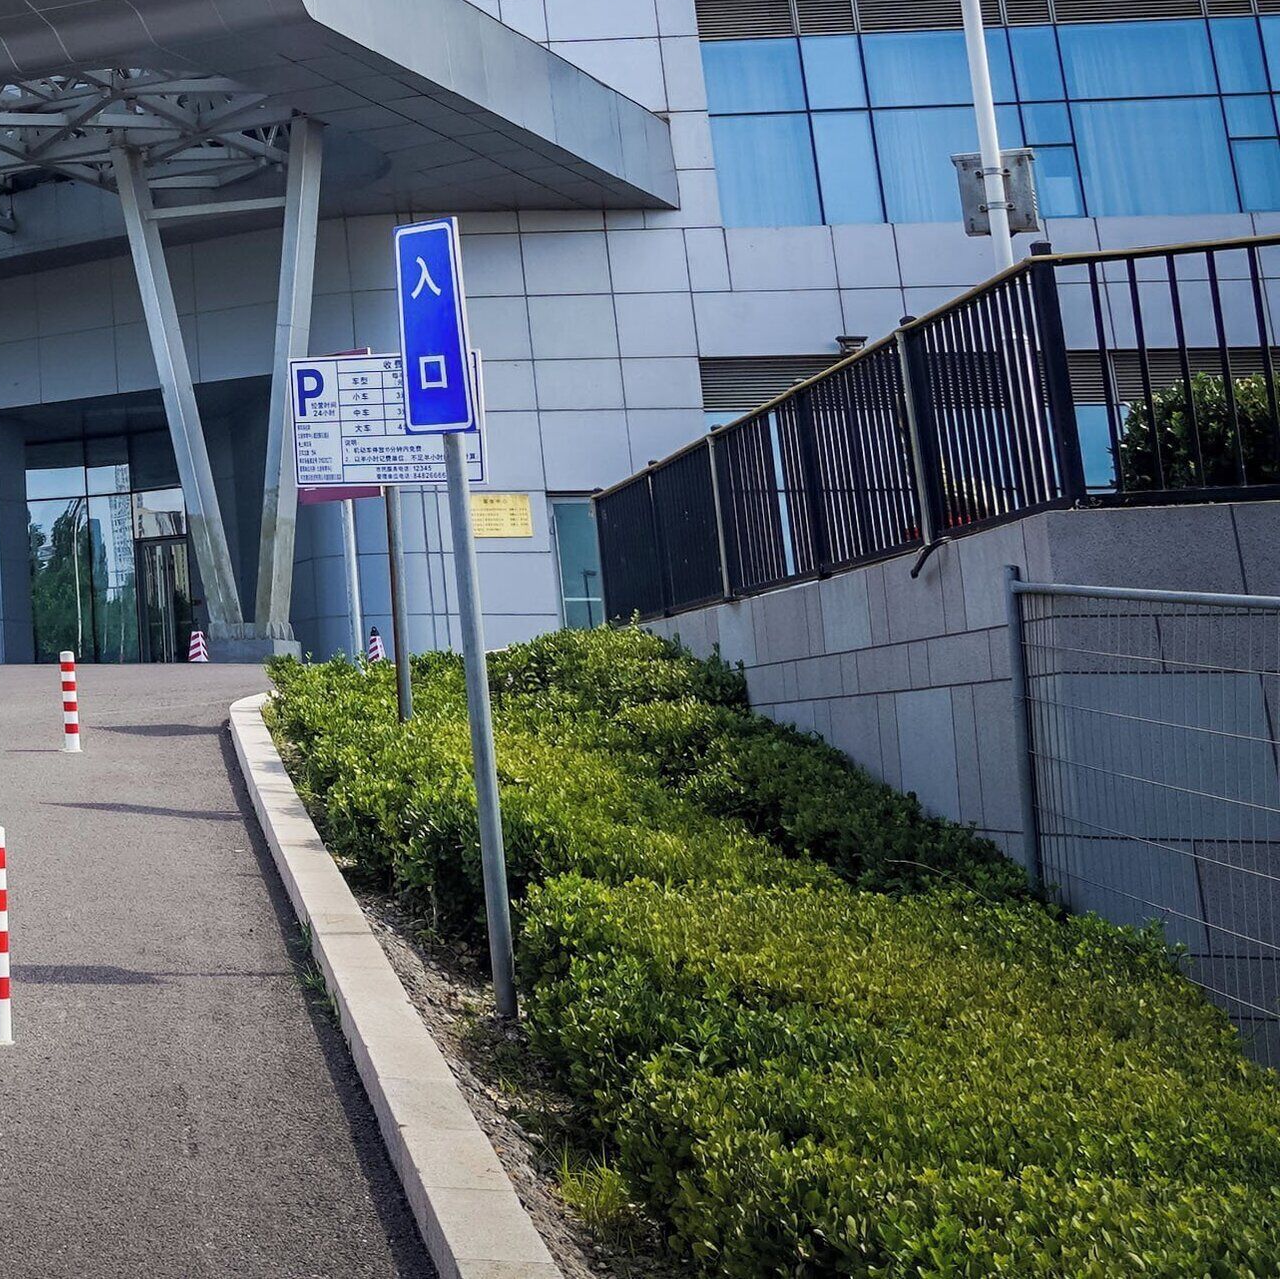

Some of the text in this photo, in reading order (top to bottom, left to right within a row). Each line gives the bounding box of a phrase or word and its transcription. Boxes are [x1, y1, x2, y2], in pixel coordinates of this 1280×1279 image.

[410, 256, 448, 390] 入口
[352, 376, 369, 385] 车型
[296, 369, 324, 417] P
[352, 391, 369, 401] 小车
[313, 409, 335, 417] 24小时
[353, 407, 370, 416] 中车
[354, 423, 371, 432] 大车
